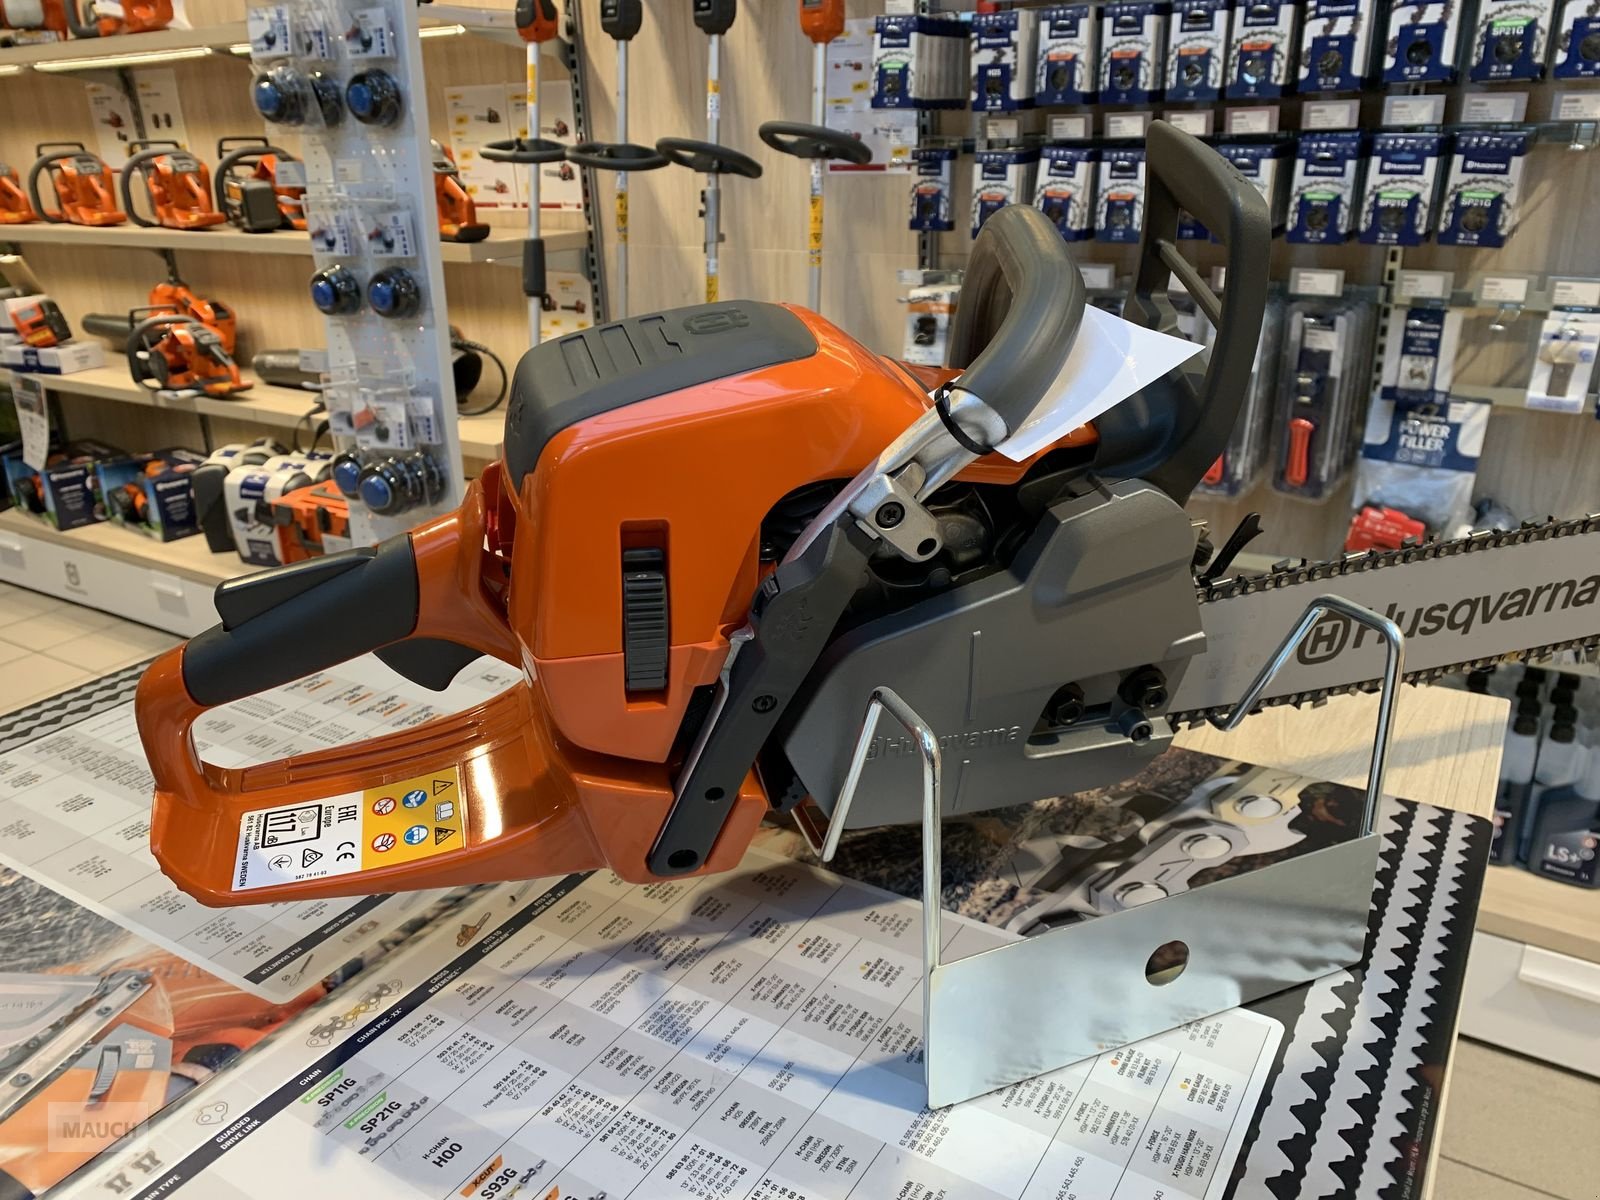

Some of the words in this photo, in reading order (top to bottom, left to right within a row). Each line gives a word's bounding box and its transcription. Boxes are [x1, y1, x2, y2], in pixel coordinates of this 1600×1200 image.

[1492, 27, 1524, 36] SP21G
[1399, 421, 1451, 439] POWER
[1399, 436, 1445, 452] FILLER
[1352, 574, 1600, 650] Husqvarna
[255, 813, 263, 841] Husqvarna
[268, 812, 296, 833] 117
[323, 805, 335, 828] Europe
[241, 832, 251, 861] Huskvarna
[253, 841, 260, 850] AB
[239, 860, 247, 887] SWEDEN
[548, 1022, 568, 1040] OREGON
[599, 1045, 620, 1065] H-CHAIN
[614, 1053, 634, 1072] OREGON
[298, 1068, 322, 1087] CHAIN
[632, 1062, 648, 1077] STIHL
[653, 1070, 673, 1090] H-CHAIN
[316, 1074, 357, 1109] SP11G
[669, 1078, 689, 1097] OREGON
[688, 1088, 703, 1103] STIHL
[541, 1105, 553, 1117] 585
[551, 1098, 560, 1107] 40
[558, 1093, 567, 1101] 42
[568, 1082, 577, 1092] XX
[358, 1097, 403, 1135] SP21G
[719, 1100, 741, 1122] H-CHAIN
[737, 1109, 757, 1129] OREGON
[214, 1115, 251, 1144] GUARDED
[219, 1130, 244, 1151] DRIVE
[241, 1117, 261, 1134] LINK
[757, 1119, 773, 1135] STIHL
[1100, 1110, 1121, 1137] LAMINATED
[421, 1135, 450, 1160] H-CHAIN
[793, 1134, 815, 1157] H-CHAIN
[1143, 1128, 1161, 1151] X-FORCE
[431, 1139, 464, 1170] H00
[813, 1143, 833, 1165] OREGON
[834, 1154, 850, 1171] STIHL
[157, 1173, 181, 1192] TYPE
[479, 1164, 519, 1200] S93G
